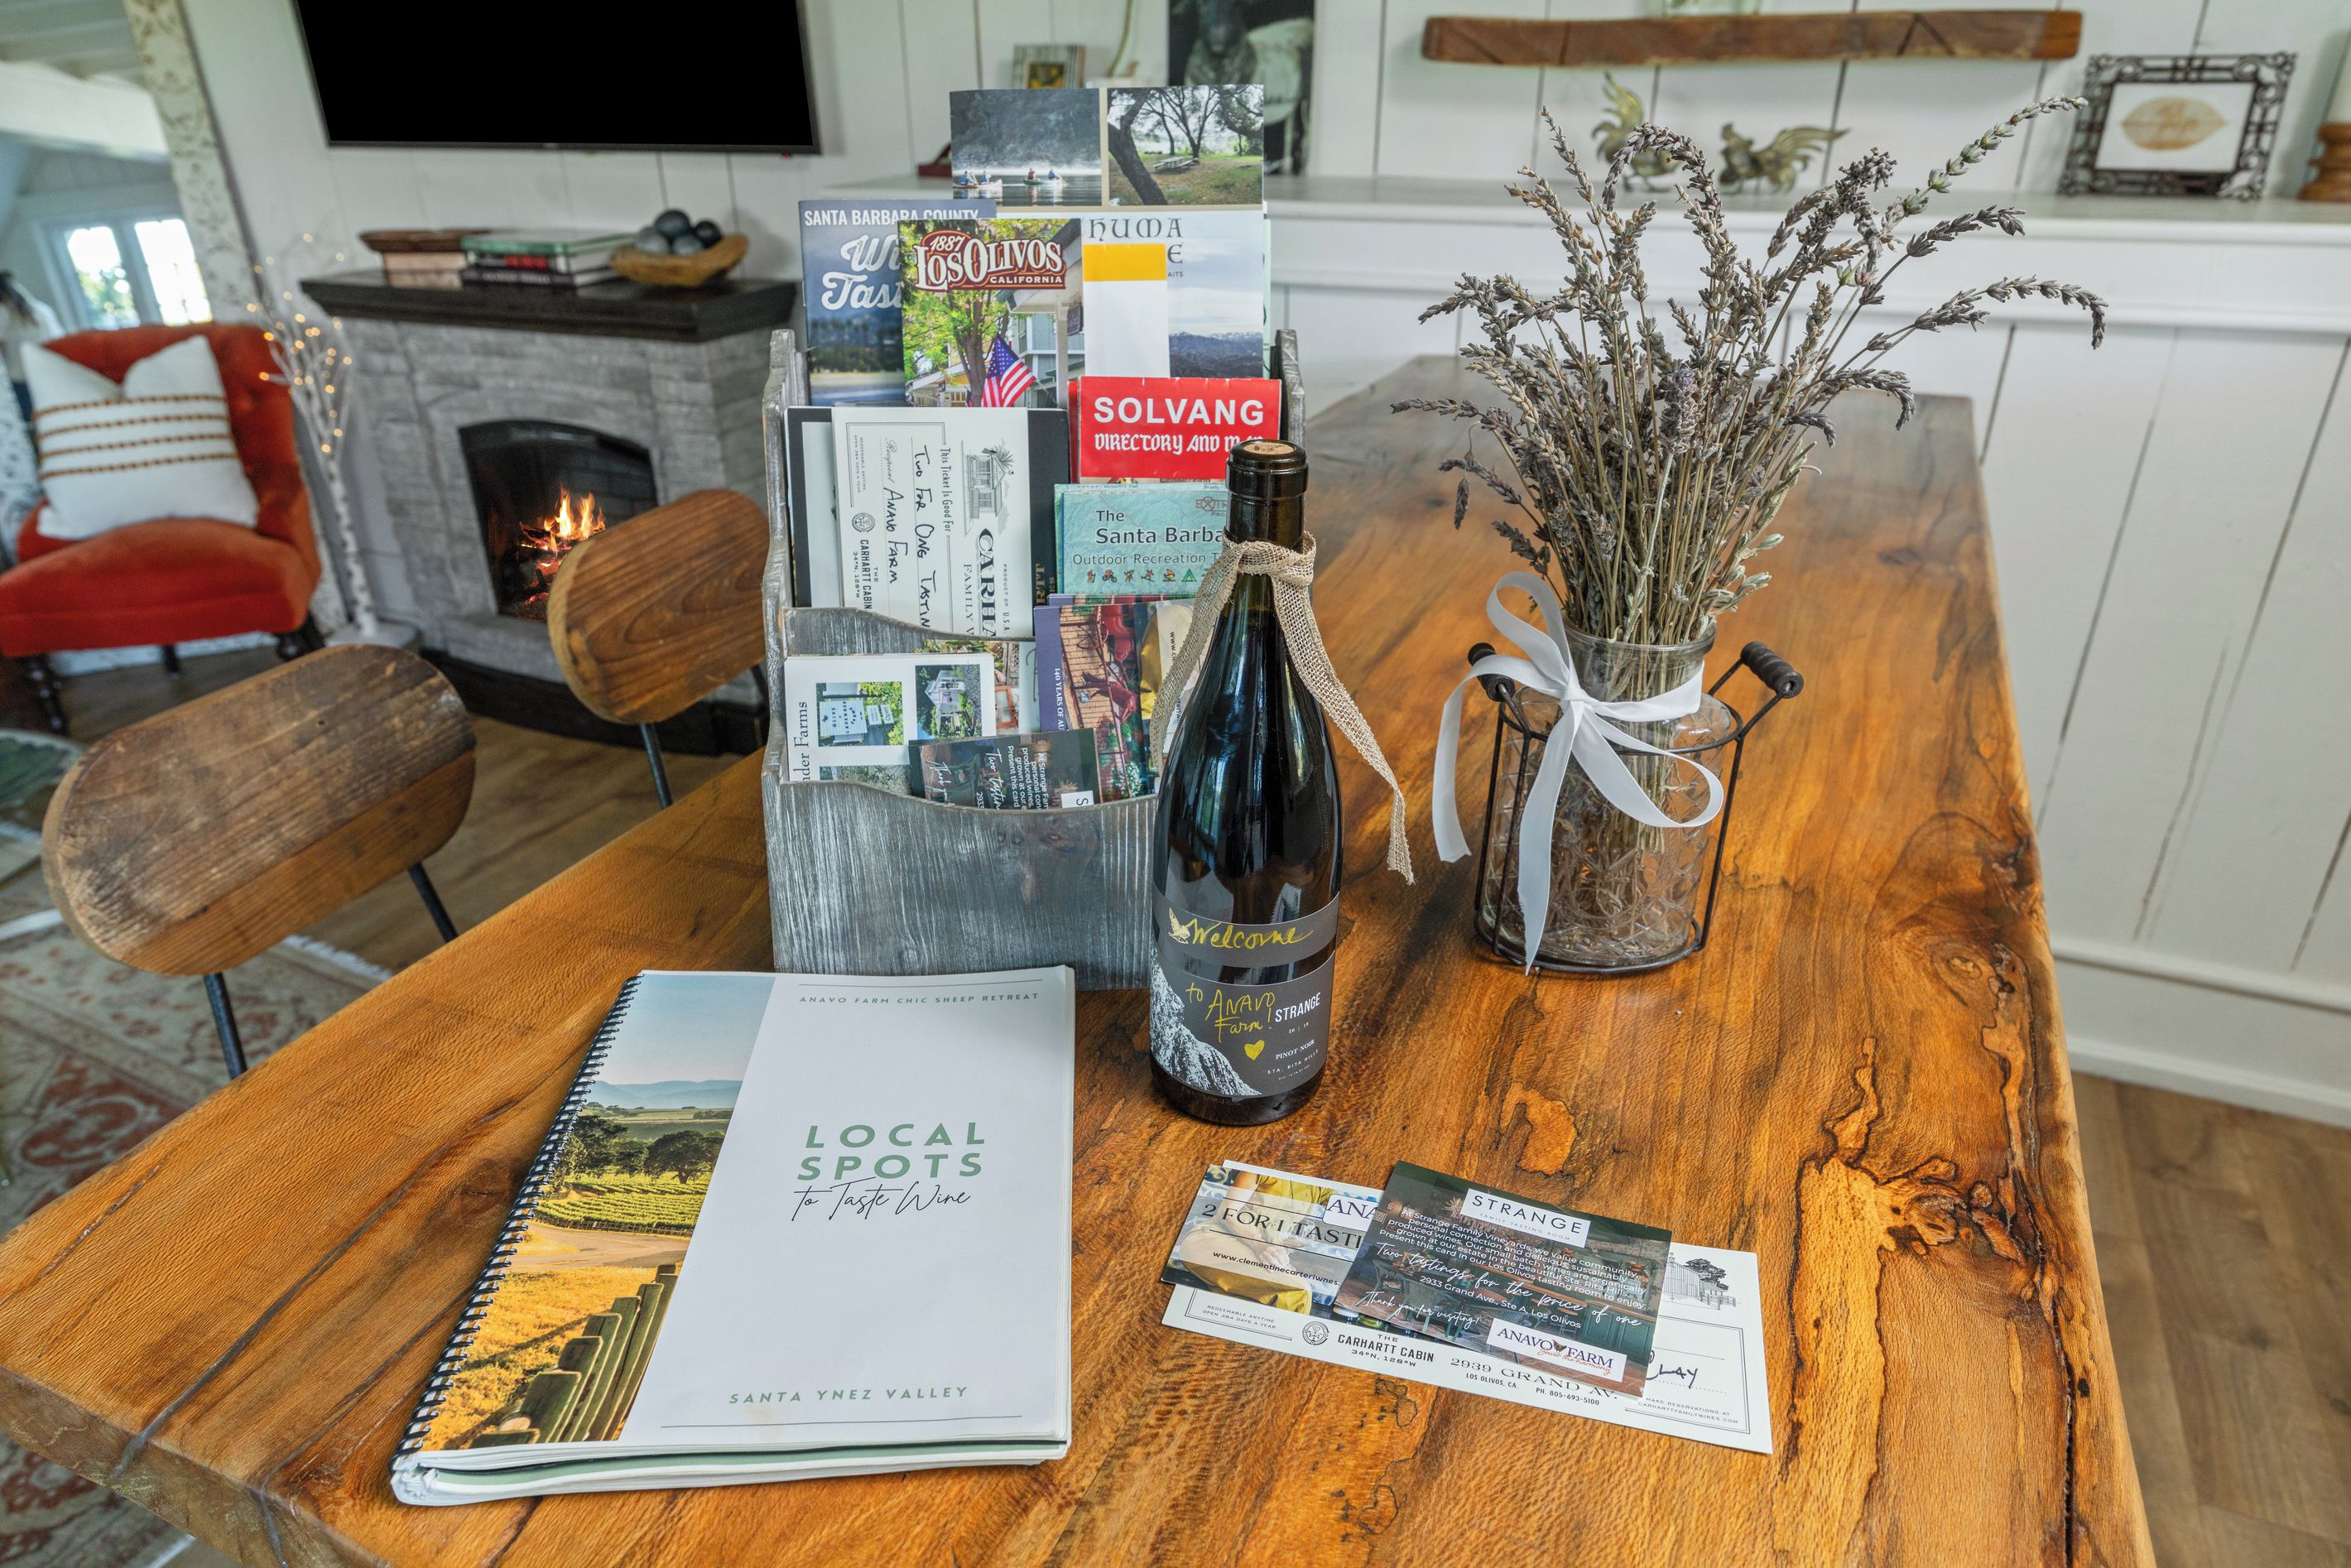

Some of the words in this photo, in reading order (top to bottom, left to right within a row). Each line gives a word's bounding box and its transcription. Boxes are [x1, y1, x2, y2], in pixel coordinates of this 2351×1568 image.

[805, 209, 849, 226] SANTA
[852, 209, 918, 225] BARBARA
[1082, 218, 1184, 241] HUMA
[929, 235, 966, 252] 1887
[989, 276, 1063, 285] CALIFORNIA
[1094, 397, 1264, 426] SOLVANG
[940, 447, 951, 464] This
[1094, 432, 1184, 455] DIRECTORY
[1186, 434, 1221, 453] AND
[940, 465, 952, 490] Ticket
[942, 498, 953, 518] Good
[1096, 510, 1125, 522] The
[943, 520, 952, 532] For
[1096, 527, 1156, 544] Santa
[860, 539, 871, 582] CARHARTT
[1073, 554, 1127, 565] Outdoor
[1133, 553, 1206, 564] Recreation
[863, 584, 873, 609] CABIN
[964, 564, 974, 621] FAMILY
[1004, 599, 1008, 607] OF
[1055, 681, 1064, 706] YEARS
[793, 701, 810, 748] Farms
[1056, 707, 1065, 718] OF
[1184, 918, 1315, 950] Welcome
[935, 995, 976, 1003] SHEEP
[981, 993, 1040, 1003] RETREAT
[1185, 982, 1204, 1003] to
[1275, 992, 1321, 1022] STRANGE
[1276, 1047, 1299, 1060] PINOT
[1300, 1039, 1315, 1052] NOIR
[1287, 1061, 1302, 1070] RITA
[805, 1122, 985, 1149] LOCAL
[797, 1152, 982, 1181] SPOTS
[791, 1186, 833, 1221] to
[829, 1176, 904, 1220] Taste
[895, 1181, 971, 1214] Wine
[1202, 1204, 1217, 1218] 2
[1222, 1208, 1271, 1229] FOR
[1472, 1195, 1582, 1234] STRANGE
[1414, 1212, 1450, 1228] Strange
[1453, 1223, 1483, 1238] Family
[1551, 1252, 1577, 1263] value
[1388, 1219, 1433, 1236] produced
[1435, 1232, 1463, 1245] wines.
[1465, 1241, 1484, 1250] Our
[1485, 1247, 1511, 1258] small
[1513, 1254, 1541, 1267] batch
[1543, 1264, 1571, 1276] wines
[1573, 1272, 1589, 1281] are
[1591, 1277, 1646, 1296] organically
[1397, 1228, 1426, 1241] grown
[1440, 1242, 1457, 1250] our
[1457, 1246, 1488, 1259] estate
[1488, 1253, 1498, 1262] in
[1500, 1258, 1517, 1267] the
[1519, 1263, 1562, 1281] beautiful
[1584, 1281, 1604, 1291] Rita
[1408, 1219, 1449, 1234] personal
[1450, 1229, 1502, 1249] connection
[1504, 1245, 1523, 1255] and
[1571, 1264, 1627, 1282] sustainably
[1379, 1229, 1415, 1245] Present
[1416, 1239, 1434, 1251] this
[1435, 1245, 1458, 1257] card
[1459, 1252, 1468, 1260] in
[1469, 1257, 1487, 1266] our
[1488, 1261, 1505, 1272] Los
[1507, 1266, 1536, 1280] Olivos
[1538, 1276, 1572, 1291] tasting
[1575, 1286, 1602, 1298] room
[1377, 1241, 1402, 1259] Two
[1409, 1253, 1471, 1282] tastings
[1474, 1272, 1499, 1289] for
[1507, 1281, 1532, 1296] the
[1537, 1293, 1584, 1311] price
[1592, 1306, 1608, 1323] of
[1616, 1315, 1642, 1326] one
[1207, 1305, 1247, 1316] REDEEMABLE
[1249, 1315, 1275, 1323] ANYTIME
[1365, 1291, 1396, 1308] Thank
[1394, 1301, 1416, 1315] you
[1416, 1304, 1435, 1319] for
[1437, 1311, 1480, 1330] visiting!
[1420, 1276, 1443, 1288] 2933
[1444, 1282, 1474, 1297] Grand
[1501, 1300, 1518, 1311] Ste
[1531, 1308, 1548, 1320] Los
[1551, 1315, 1581, 1329] Olivos
[1337, 1334, 1397, 1354] CARHARTT
[1400, 1347, 1435, 1363] CABIN
[1377, 1334, 1399, 1342] THE
[1497, 1328, 1553, 1351] ANAVO
[1566, 1346, 1614, 1368] FARM
[1450, 1358, 1492, 1373] 2939
[1501, 1368, 1581, 1391] GRAND
[1589, 1387, 1618, 1399] AV.
[1480, 1375, 1506, 1387] OLIVOS,
[1549, 1390, 1600, 1406] 805-693-5100
[729, 1391, 803, 1404] SANTA
[817, 1388, 874, 1401] YNEZ
[886, 1387, 968, 1400] VALLEY
[1646, 1397, 1665, 1405] MAKE
[1667, 1401, 1719, 1415] RESERVATIONS
[1638, 1402, 1738, 1424] CARHARTTFAMILYWINES.COM
